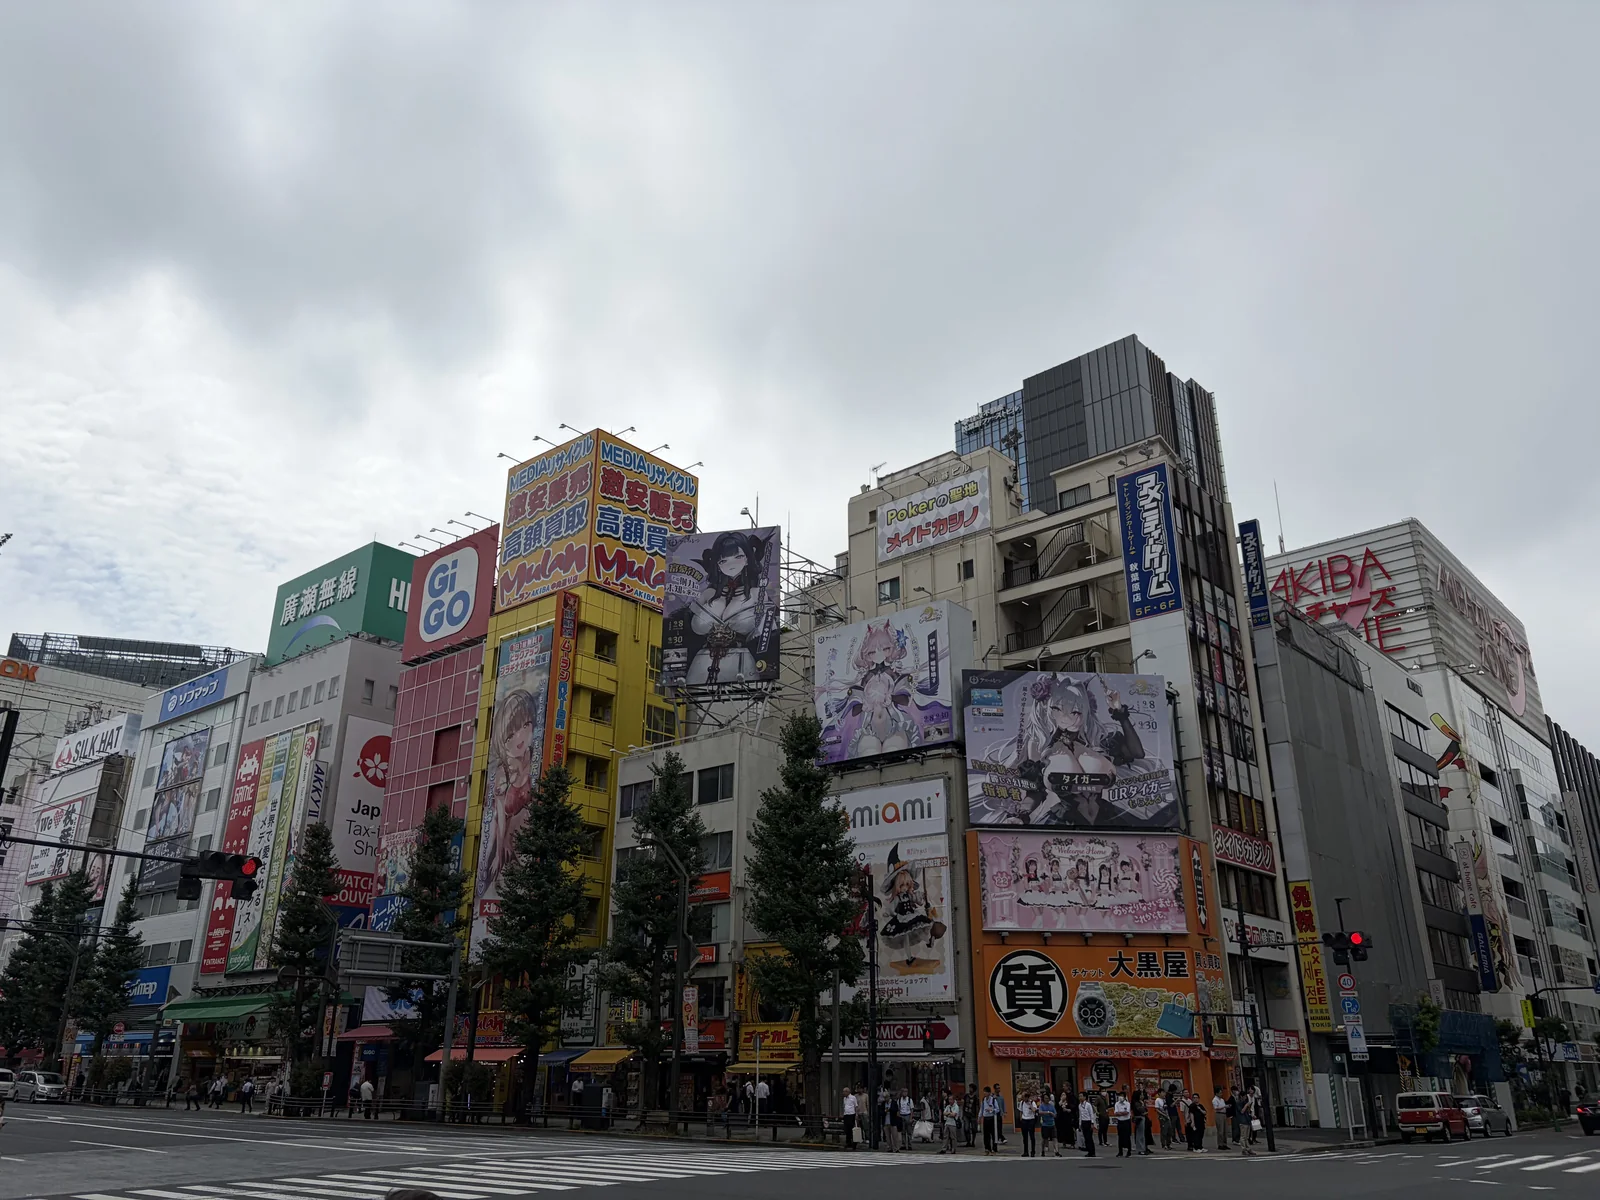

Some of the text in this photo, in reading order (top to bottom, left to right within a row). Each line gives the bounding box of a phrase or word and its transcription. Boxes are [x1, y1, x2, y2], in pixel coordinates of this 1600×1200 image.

[509, 434, 594, 494] MEDIAリサイクル
[601, 440, 696, 496] MEDIAリサイクル
[507, 462, 592, 525] 激安販売
[599, 466, 694, 530] 激安販売
[886, 480, 979, 526] Pokerの聖地
[502, 500, 588, 564] 高額買取
[597, 505, 667, 557] 高額買
[886, 505, 979, 554] メイドカジノ
[428, 558, 459, 599] Gi
[499, 542, 588, 606] Mulan
[1129, 562, 1142, 603] 秋葉原店
[1270, 546, 1392, 603] AKIBA
[423, 590, 471, 635] GO
[558, 639, 573, 682] ムーラン
[178, 679, 219, 706] ソフマップ
[73, 725, 124, 762] SILK HAT
[233, 783, 255, 804] GAME
[311, 764, 326, 807] AKKY
[1062, 774, 1101, 785] タイガー
[1108, 781, 1172, 803] URタイガー
[40, 815, 53, 833] We
[1054, 845, 1107, 856] Welcome Home
[1214, 829, 1272, 869] メイドカジノ
[1291, 885, 1316, 933] 免税
[1072, 950, 1189, 979] チケット 大黒屋
[1476, 931, 1491, 974] GALLERIA
[998, 962, 1059, 1023] 質
[1313, 967, 1329, 1006] FREE
[1342, 978, 1353, 987] 40
[1311, 1021, 1332, 1029] TOKIS
[1094, 1064, 1113, 1086] 質
